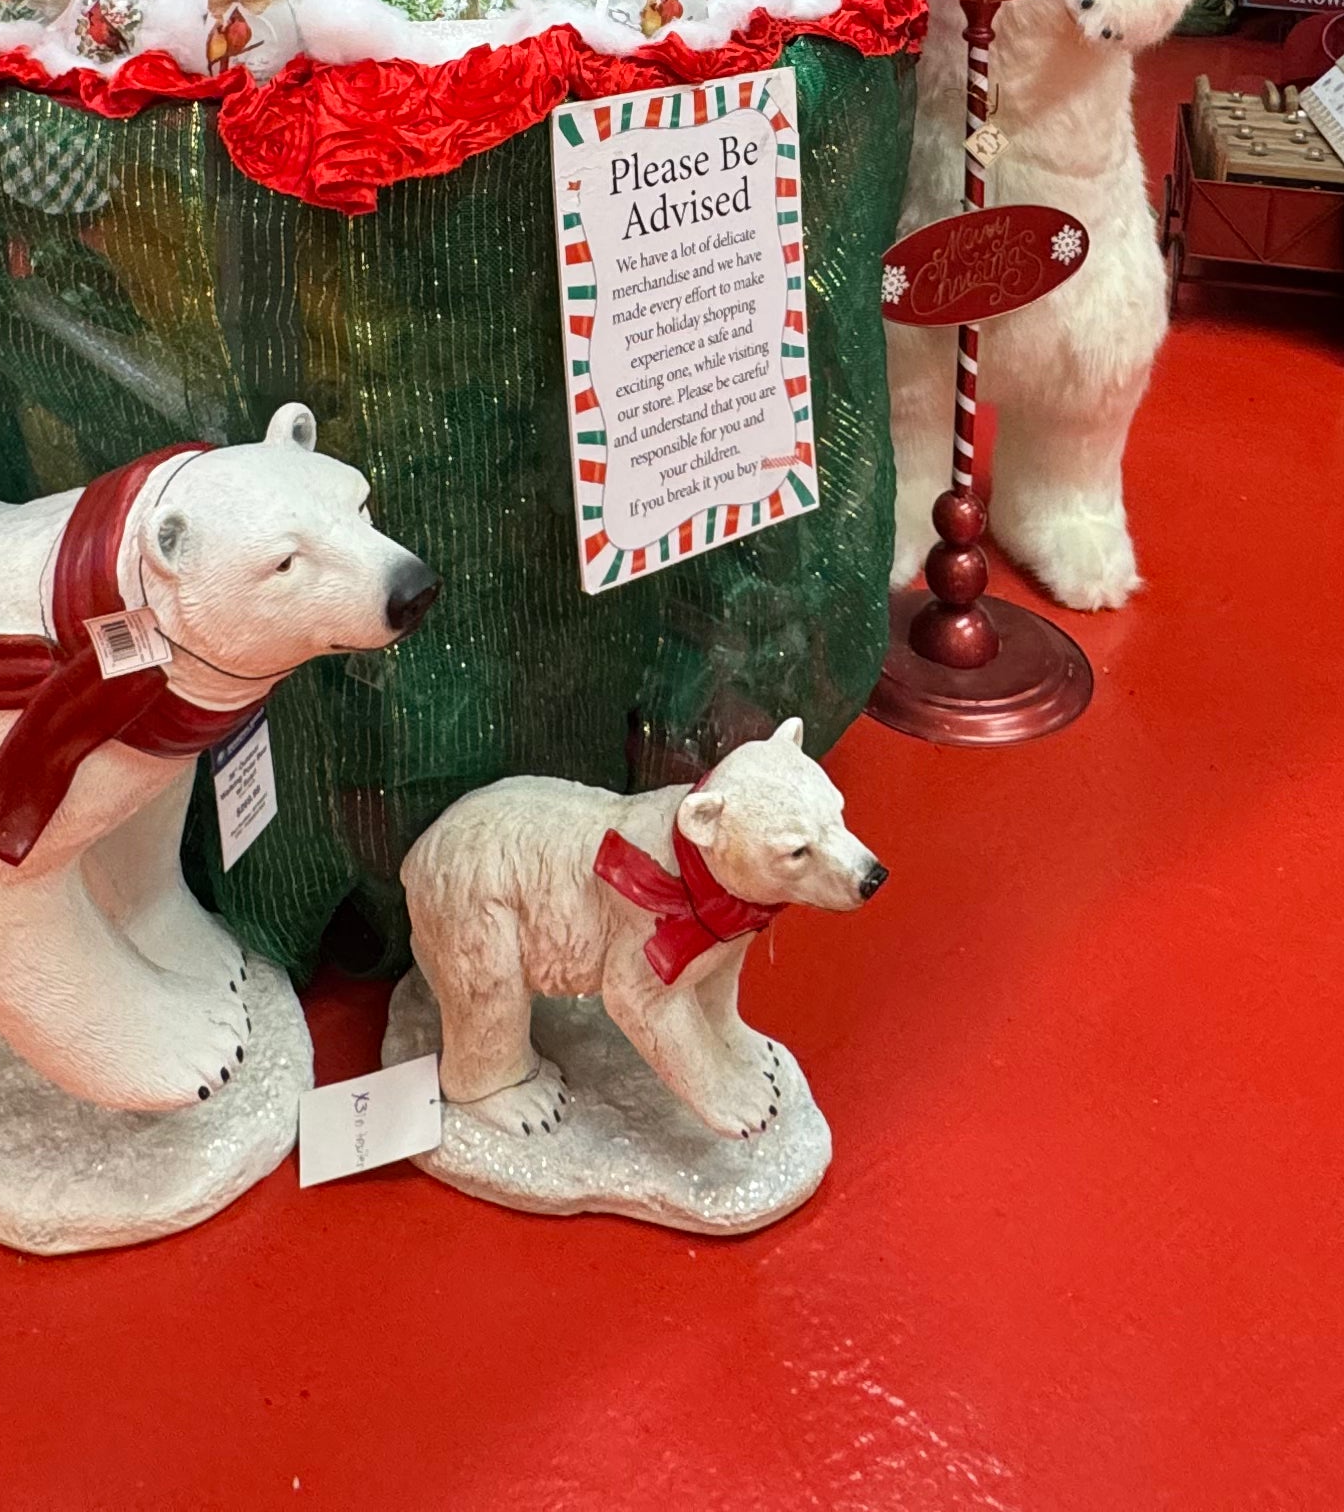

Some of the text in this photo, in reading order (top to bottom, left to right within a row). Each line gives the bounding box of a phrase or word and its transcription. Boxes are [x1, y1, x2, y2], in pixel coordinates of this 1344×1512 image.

[610, 136, 758, 195] Please Be
[621, 175, 751, 240] Advised
[612, 251, 762, 300] merchandise and we have
[616, 229, 756, 273] We have a lot of delicate
[612, 272, 765, 325] made every effort to make
[625, 300, 756, 351] your holiday shopping
[631, 319, 753, 370] experience a safe and
[616, 342, 769, 397] exciting one, while visiting
[614, 385, 776, 449] and understand that you are
[617, 406, 640, 422] our
[642, 398, 675, 415] store.
[678, 381, 714, 403] Please
[716, 375, 729, 389] be
[630, 408, 764, 467] responsible for you and
[629, 459, 759, 518] If you break it you buy
[659, 445, 740, 486] your children.
